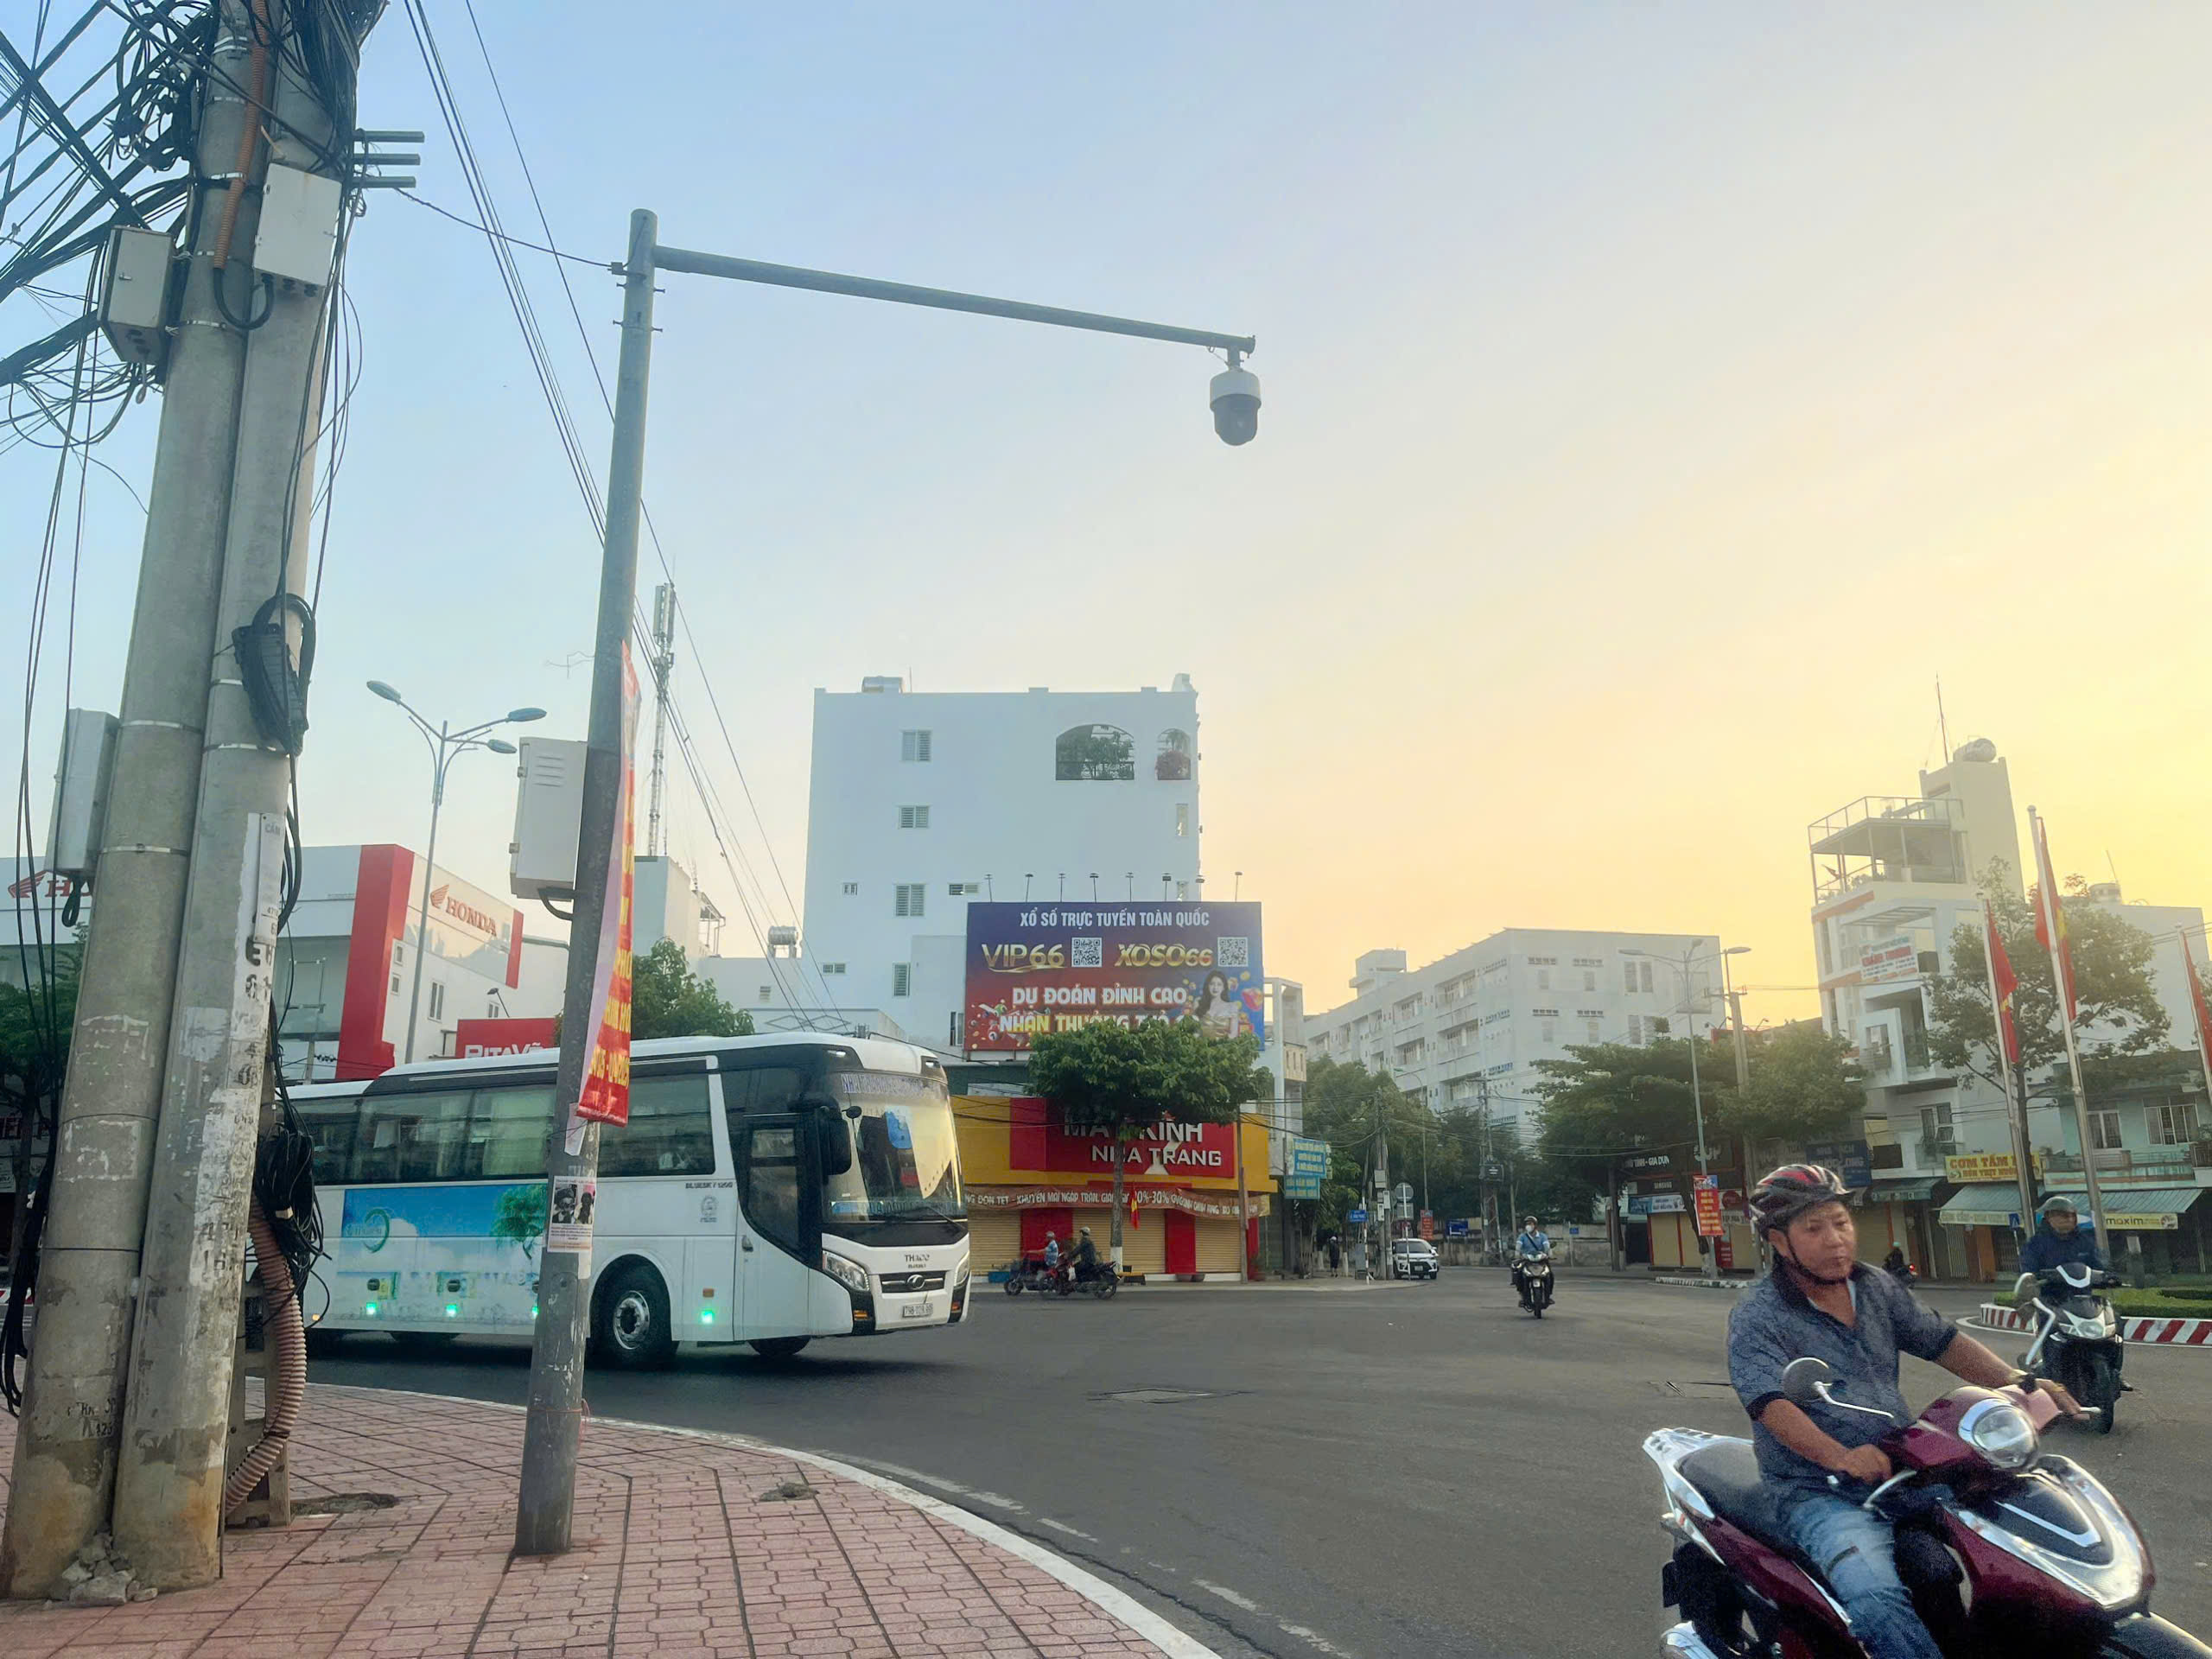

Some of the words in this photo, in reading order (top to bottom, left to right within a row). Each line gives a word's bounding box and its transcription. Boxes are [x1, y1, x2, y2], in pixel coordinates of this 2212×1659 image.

[446, 896, 497, 938] HONDA
[1020, 907, 1038, 927] XỔ
[1040, 907, 1058, 927] SỐ
[1060, 911, 1093, 930] TRỰC
[1096, 907, 1135, 927] TUYẾN
[1139, 909, 1172, 926] TOÀN
[1175, 907, 1210, 928] QUỐC
[982, 944, 1065, 969] VIP66
[1043, 983, 1096, 1005] ĐOÁN
[1102, 982, 1146, 1005] ĐỈNH
[1150, 987, 1187, 1005] CAO
[1148, 1147, 1222, 1166] TRANG
